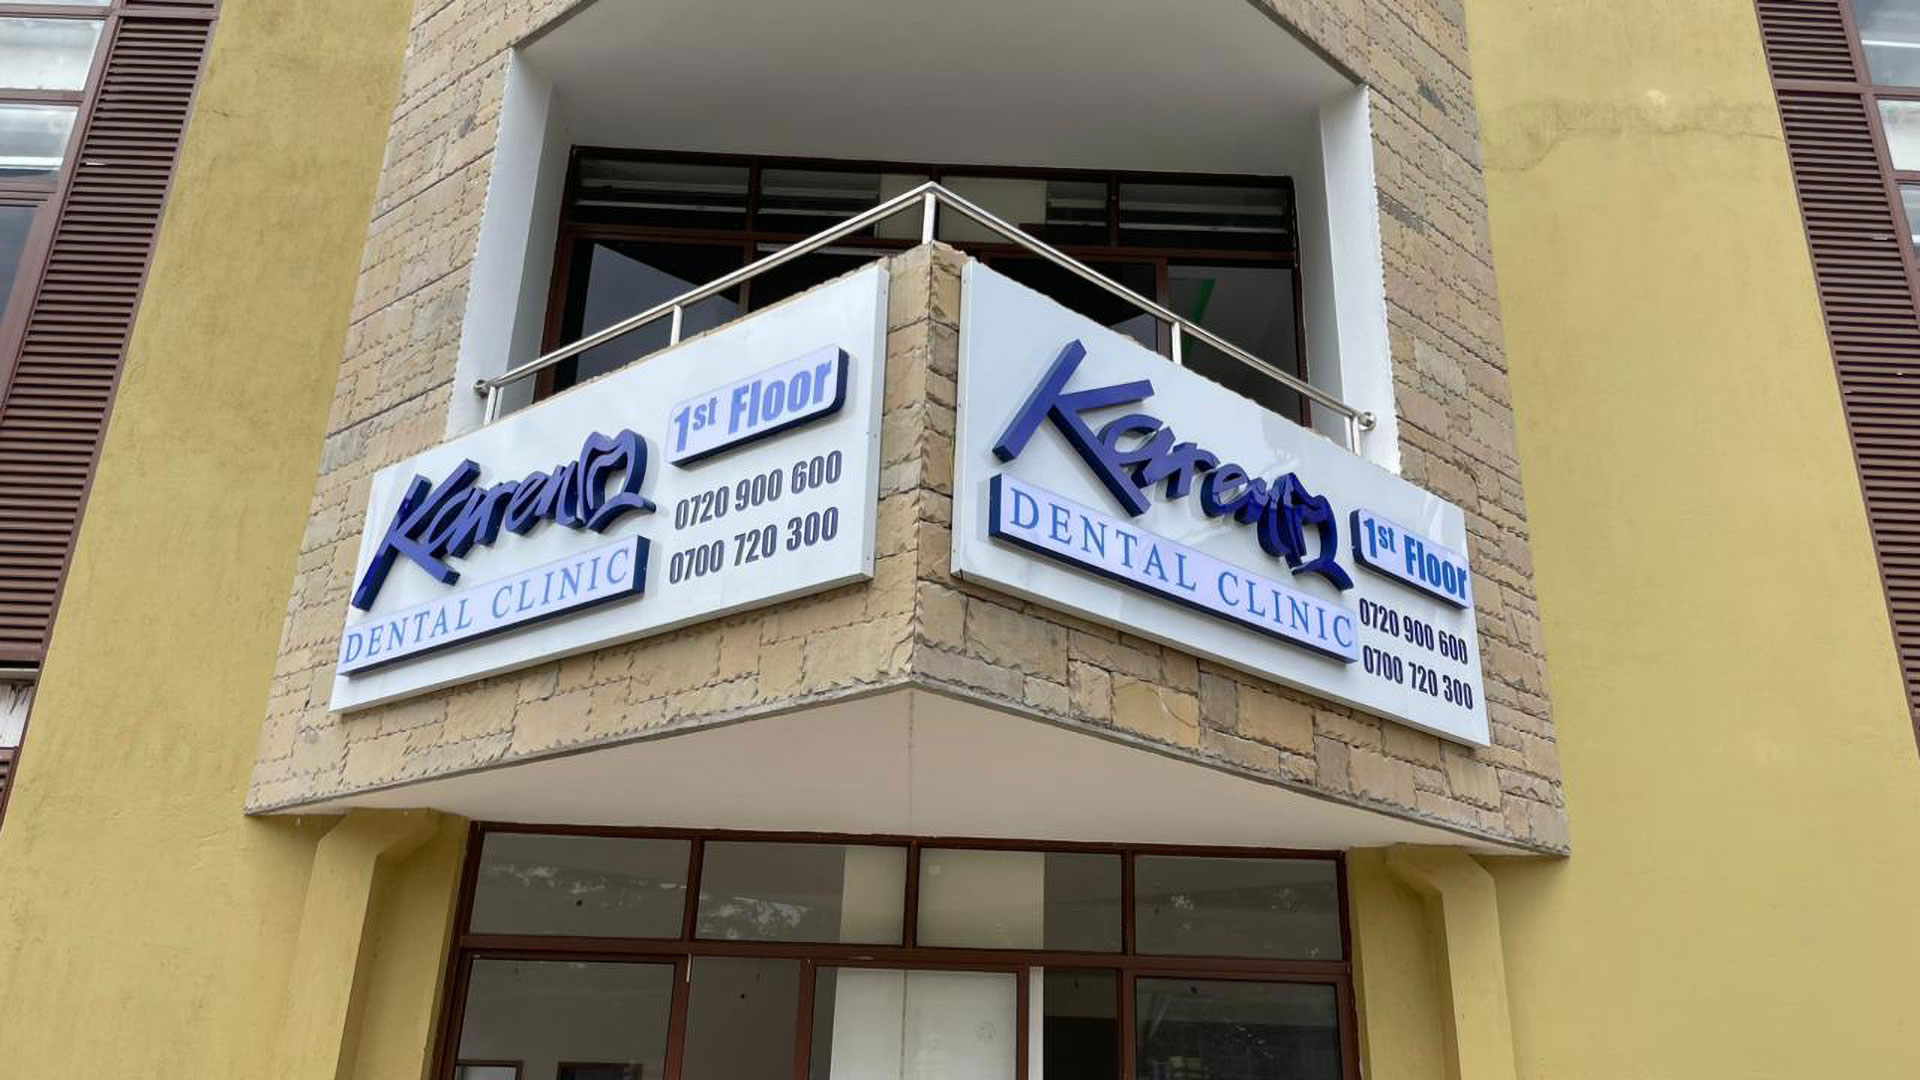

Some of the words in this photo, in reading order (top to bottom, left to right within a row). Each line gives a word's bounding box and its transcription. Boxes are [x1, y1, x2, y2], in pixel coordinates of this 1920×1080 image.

[674, 396, 718, 453] 1st
[728, 360, 832, 434] Floor
[675, 486, 729, 530] 0720
[735, 469, 783, 511] 900
[791, 450, 842, 494] 600
[669, 540, 724, 584] 0700
[734, 524, 777, 566] 720
[786, 507, 839, 551] 300
[1010, 488, 1197, 591] DENTAL
[1218, 572, 1352, 648] CLINIC
[1363, 518, 1396, 559] 1st
[1404, 535, 1467, 600] Floor
[343, 598, 473, 664] DENTAL
[492, 549, 629, 619] CLINIC
[1359, 598, 1399, 637] 0720
[1403, 616, 1434, 651] 900
[1439, 630, 1467, 664] 600
[1363, 645, 1403, 684] 0700
[1409, 662, 1438, 697] 720
[1443, 675, 1473, 710] 300
